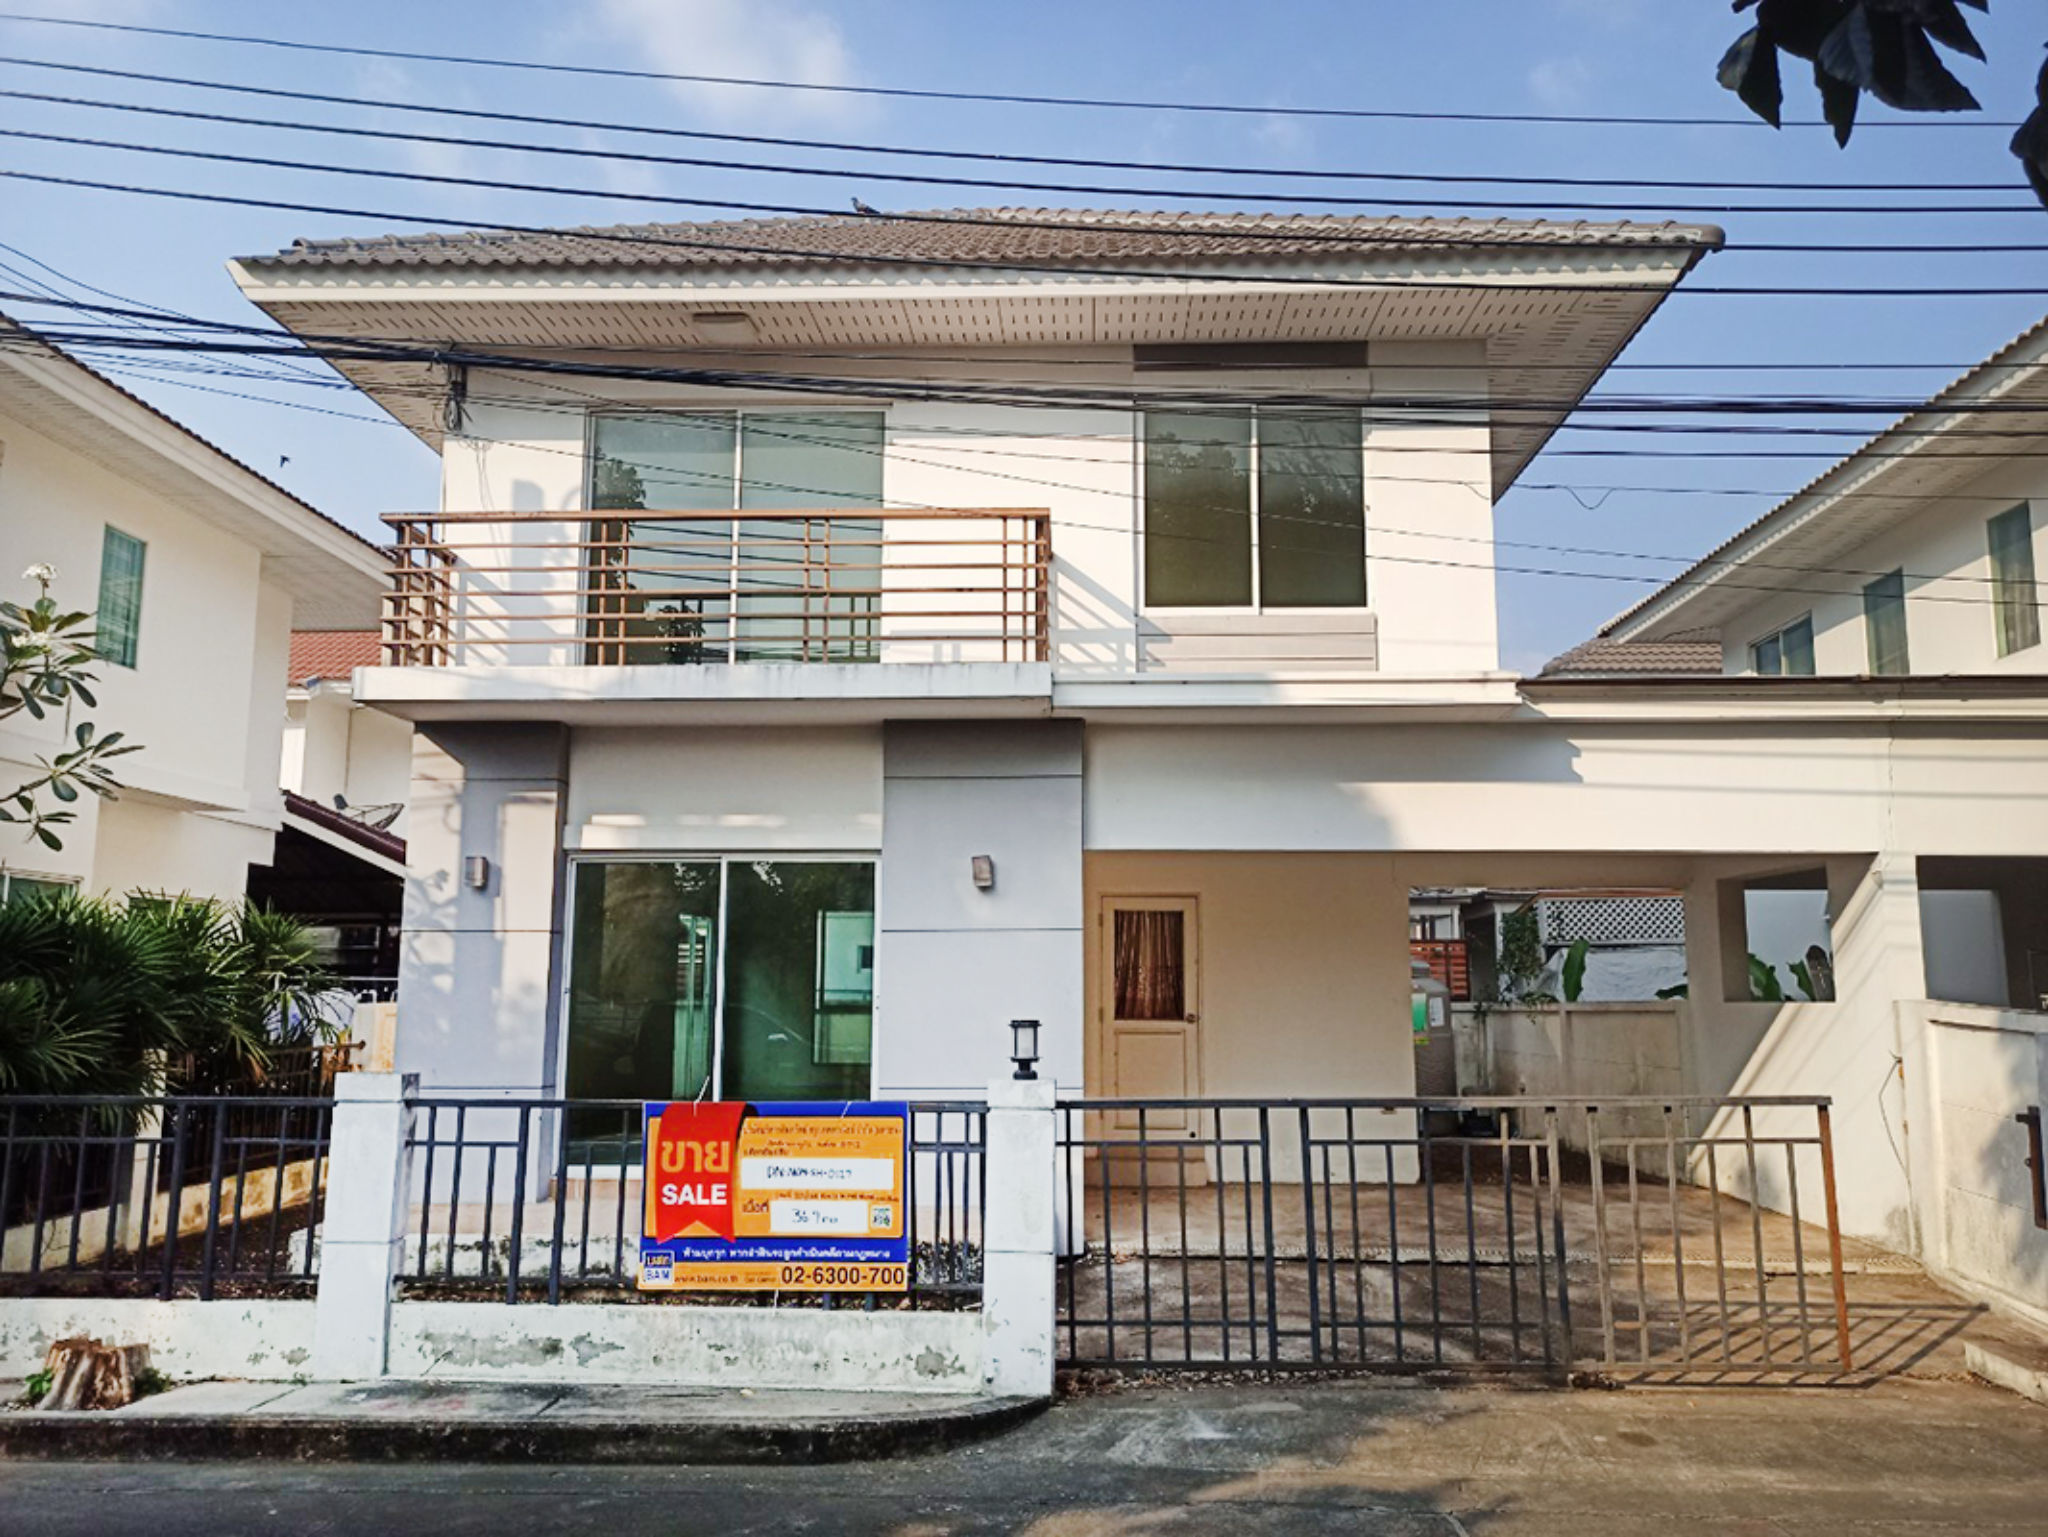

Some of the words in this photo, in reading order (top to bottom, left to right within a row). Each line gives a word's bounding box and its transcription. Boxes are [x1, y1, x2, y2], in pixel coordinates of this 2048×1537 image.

[661, 1141, 730, 1173] ขาย
[661, 1183, 727, 1205] SALE
[646, 1269, 670, 1280] BAM
[781, 1266, 904, 1285] 02-6300-700
